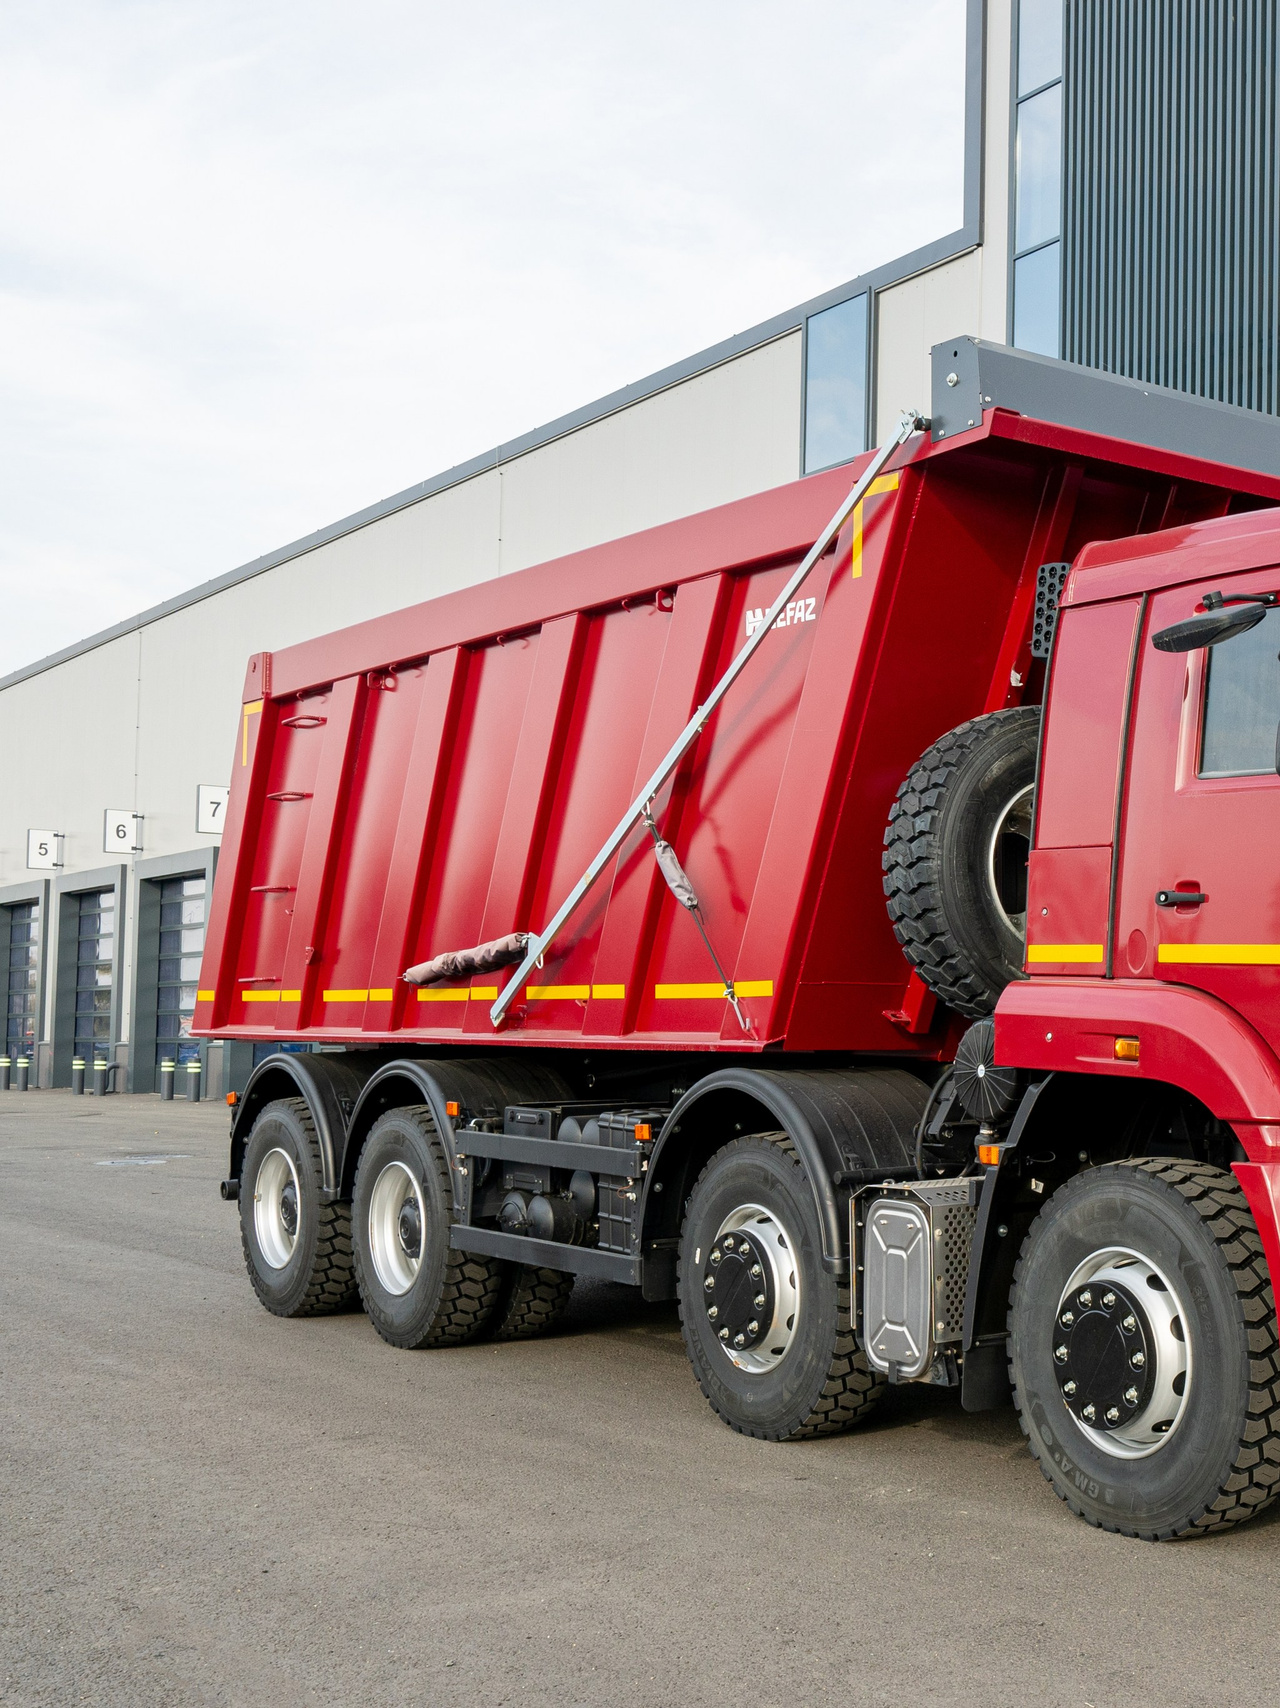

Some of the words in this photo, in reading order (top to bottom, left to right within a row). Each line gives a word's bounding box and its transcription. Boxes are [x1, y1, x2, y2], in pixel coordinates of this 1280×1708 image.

[209, 801, 222, 818] 7
[115, 824, 127, 839] 6
[38, 842, 49, 856] 5
